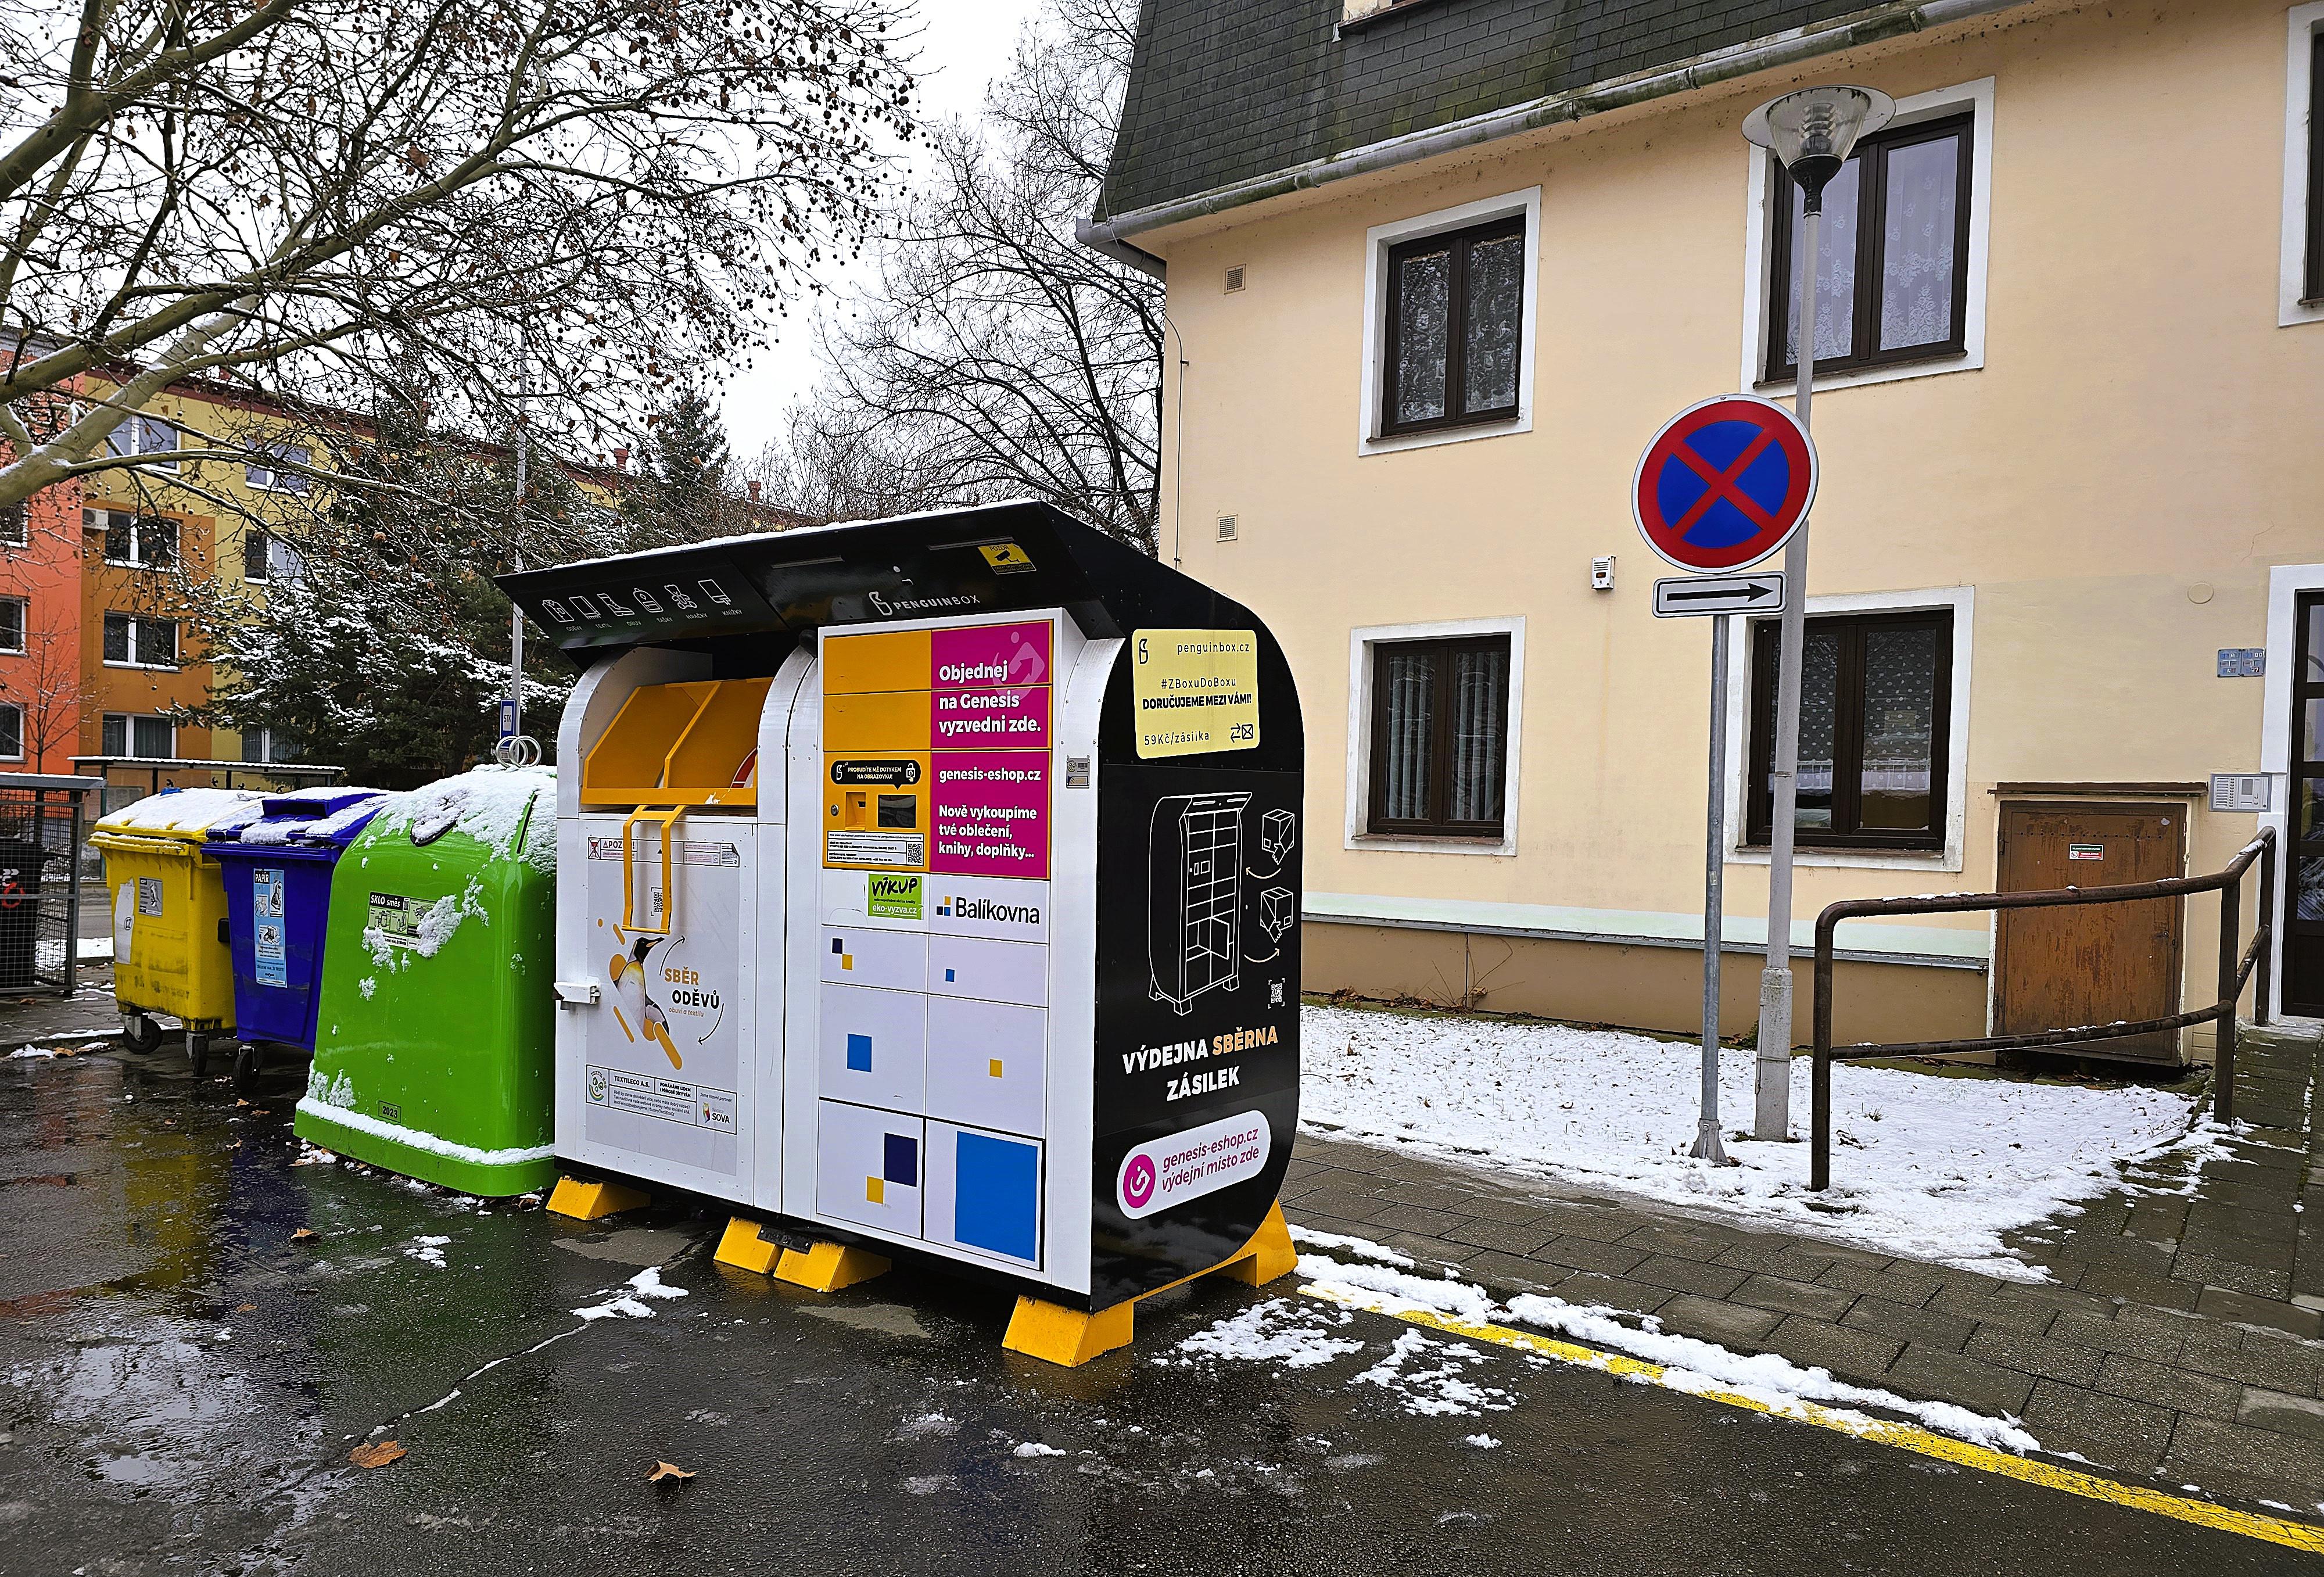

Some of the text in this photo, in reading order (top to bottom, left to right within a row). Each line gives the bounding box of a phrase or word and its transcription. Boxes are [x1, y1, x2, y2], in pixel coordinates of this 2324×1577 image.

[893, 594, 980, 610] PENGUINBOX
[1177, 641, 1249, 655] penguinbox.cz
[939, 660, 1007, 684] Objednej
[1161, 677, 1236, 689] #ZBoxuDoBoxu
[939, 690, 1020, 709] na Genesis
[1142, 691, 1251, 710] DORUČUJEME MEZI VÁMI!
[939, 715, 1041, 737] vyzvedni zde.
[1145, 730, 1209, 746] 59Kč/zásilka
[939, 766, 1041, 783] genesis-eshop.cz
[939, 804, 1037, 822] Nově vykoupíme
[938, 823, 1013, 840] tvé oblečení,
[938, 840, 1034, 861] knihy, doplňky...
[255, 872, 269, 883] PAPÍR
[871, 876, 918, 897] VÝKUP
[371, 894, 400, 908] SKLO směs
[872, 903, 917, 915] eko-vyzva.cz
[956, 897, 1040, 924] Balíkovna
[664, 966, 699, 985] SBĚR
[672, 988, 719, 1009] ODĚVŮ
[1122, 1026, 1279, 1074] VÝDEJNA SBĚRNA
[614, 1076, 640, 1086] TEXTILECO
[1167, 1066, 1240, 1102] ZÁSILEK
[382, 1106, 397, 1118] 2023
[712, 1112, 730, 1124] SOVA
[1163, 1128, 1259, 1173] genesis-eshop.cz
[1162, 1146, 1259, 1193] výdejní místo zde
